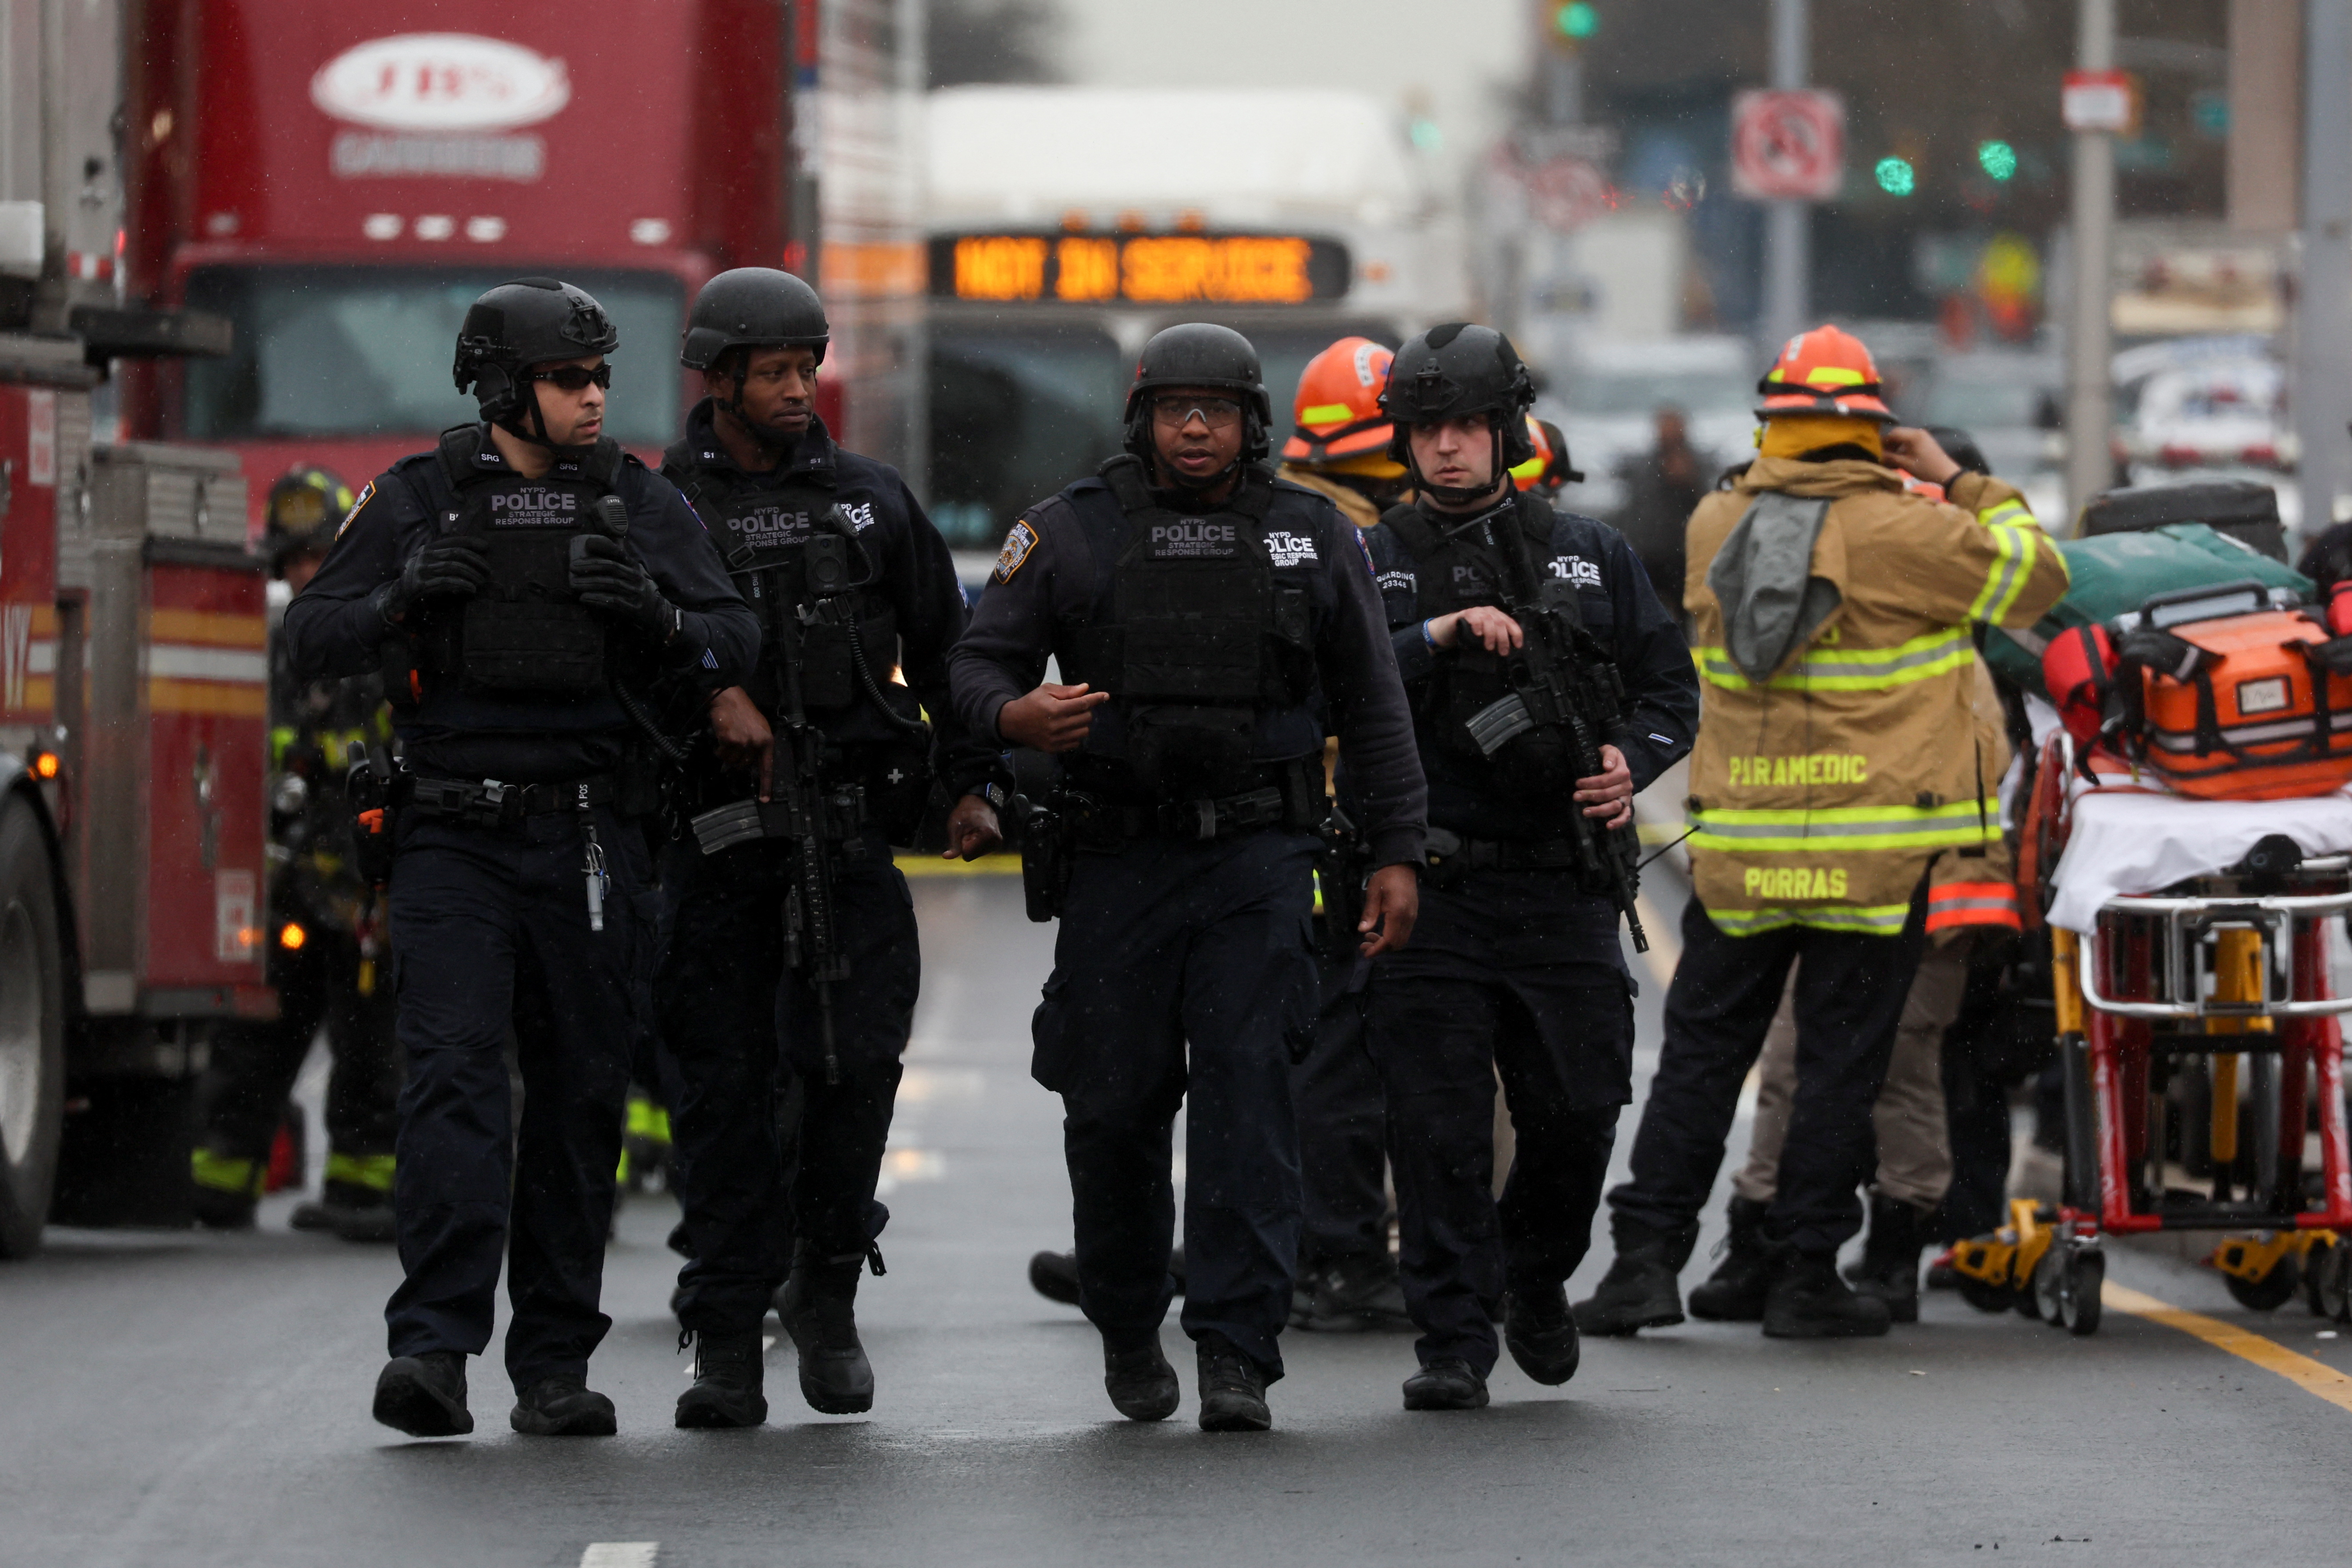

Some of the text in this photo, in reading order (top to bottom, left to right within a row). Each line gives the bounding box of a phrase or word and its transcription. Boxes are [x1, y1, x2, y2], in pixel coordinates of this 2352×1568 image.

[954, 236, 1047, 300] NOT
[1121, 236, 1313, 303] SERVICE
[481, 453, 499, 462] SRG
[491, 493, 576, 511] POLICE
[754, 507, 779, 515] NYPD
[727, 511, 810, 533] POLICE
[855, 518, 875, 532] SPONSE
[745, 531, 791, 541] STRATEGIC
[1152, 525, 1235, 542] POLICE
[744, 539, 778, 548] PONSE
[1263, 537, 1315, 553] OLICE
[1274, 558, 1299, 567] GROUP
[1377, 571, 1415, 583] GUARDINO
[1547, 561, 1601, 580] OLICE
[1382, 579, 1407, 589] 23348
[1729, 754, 1868, 786] PARAMEDIC
[579, 784, 588, 799] POS
[1745, 868, 1848, 899] PORRAS
